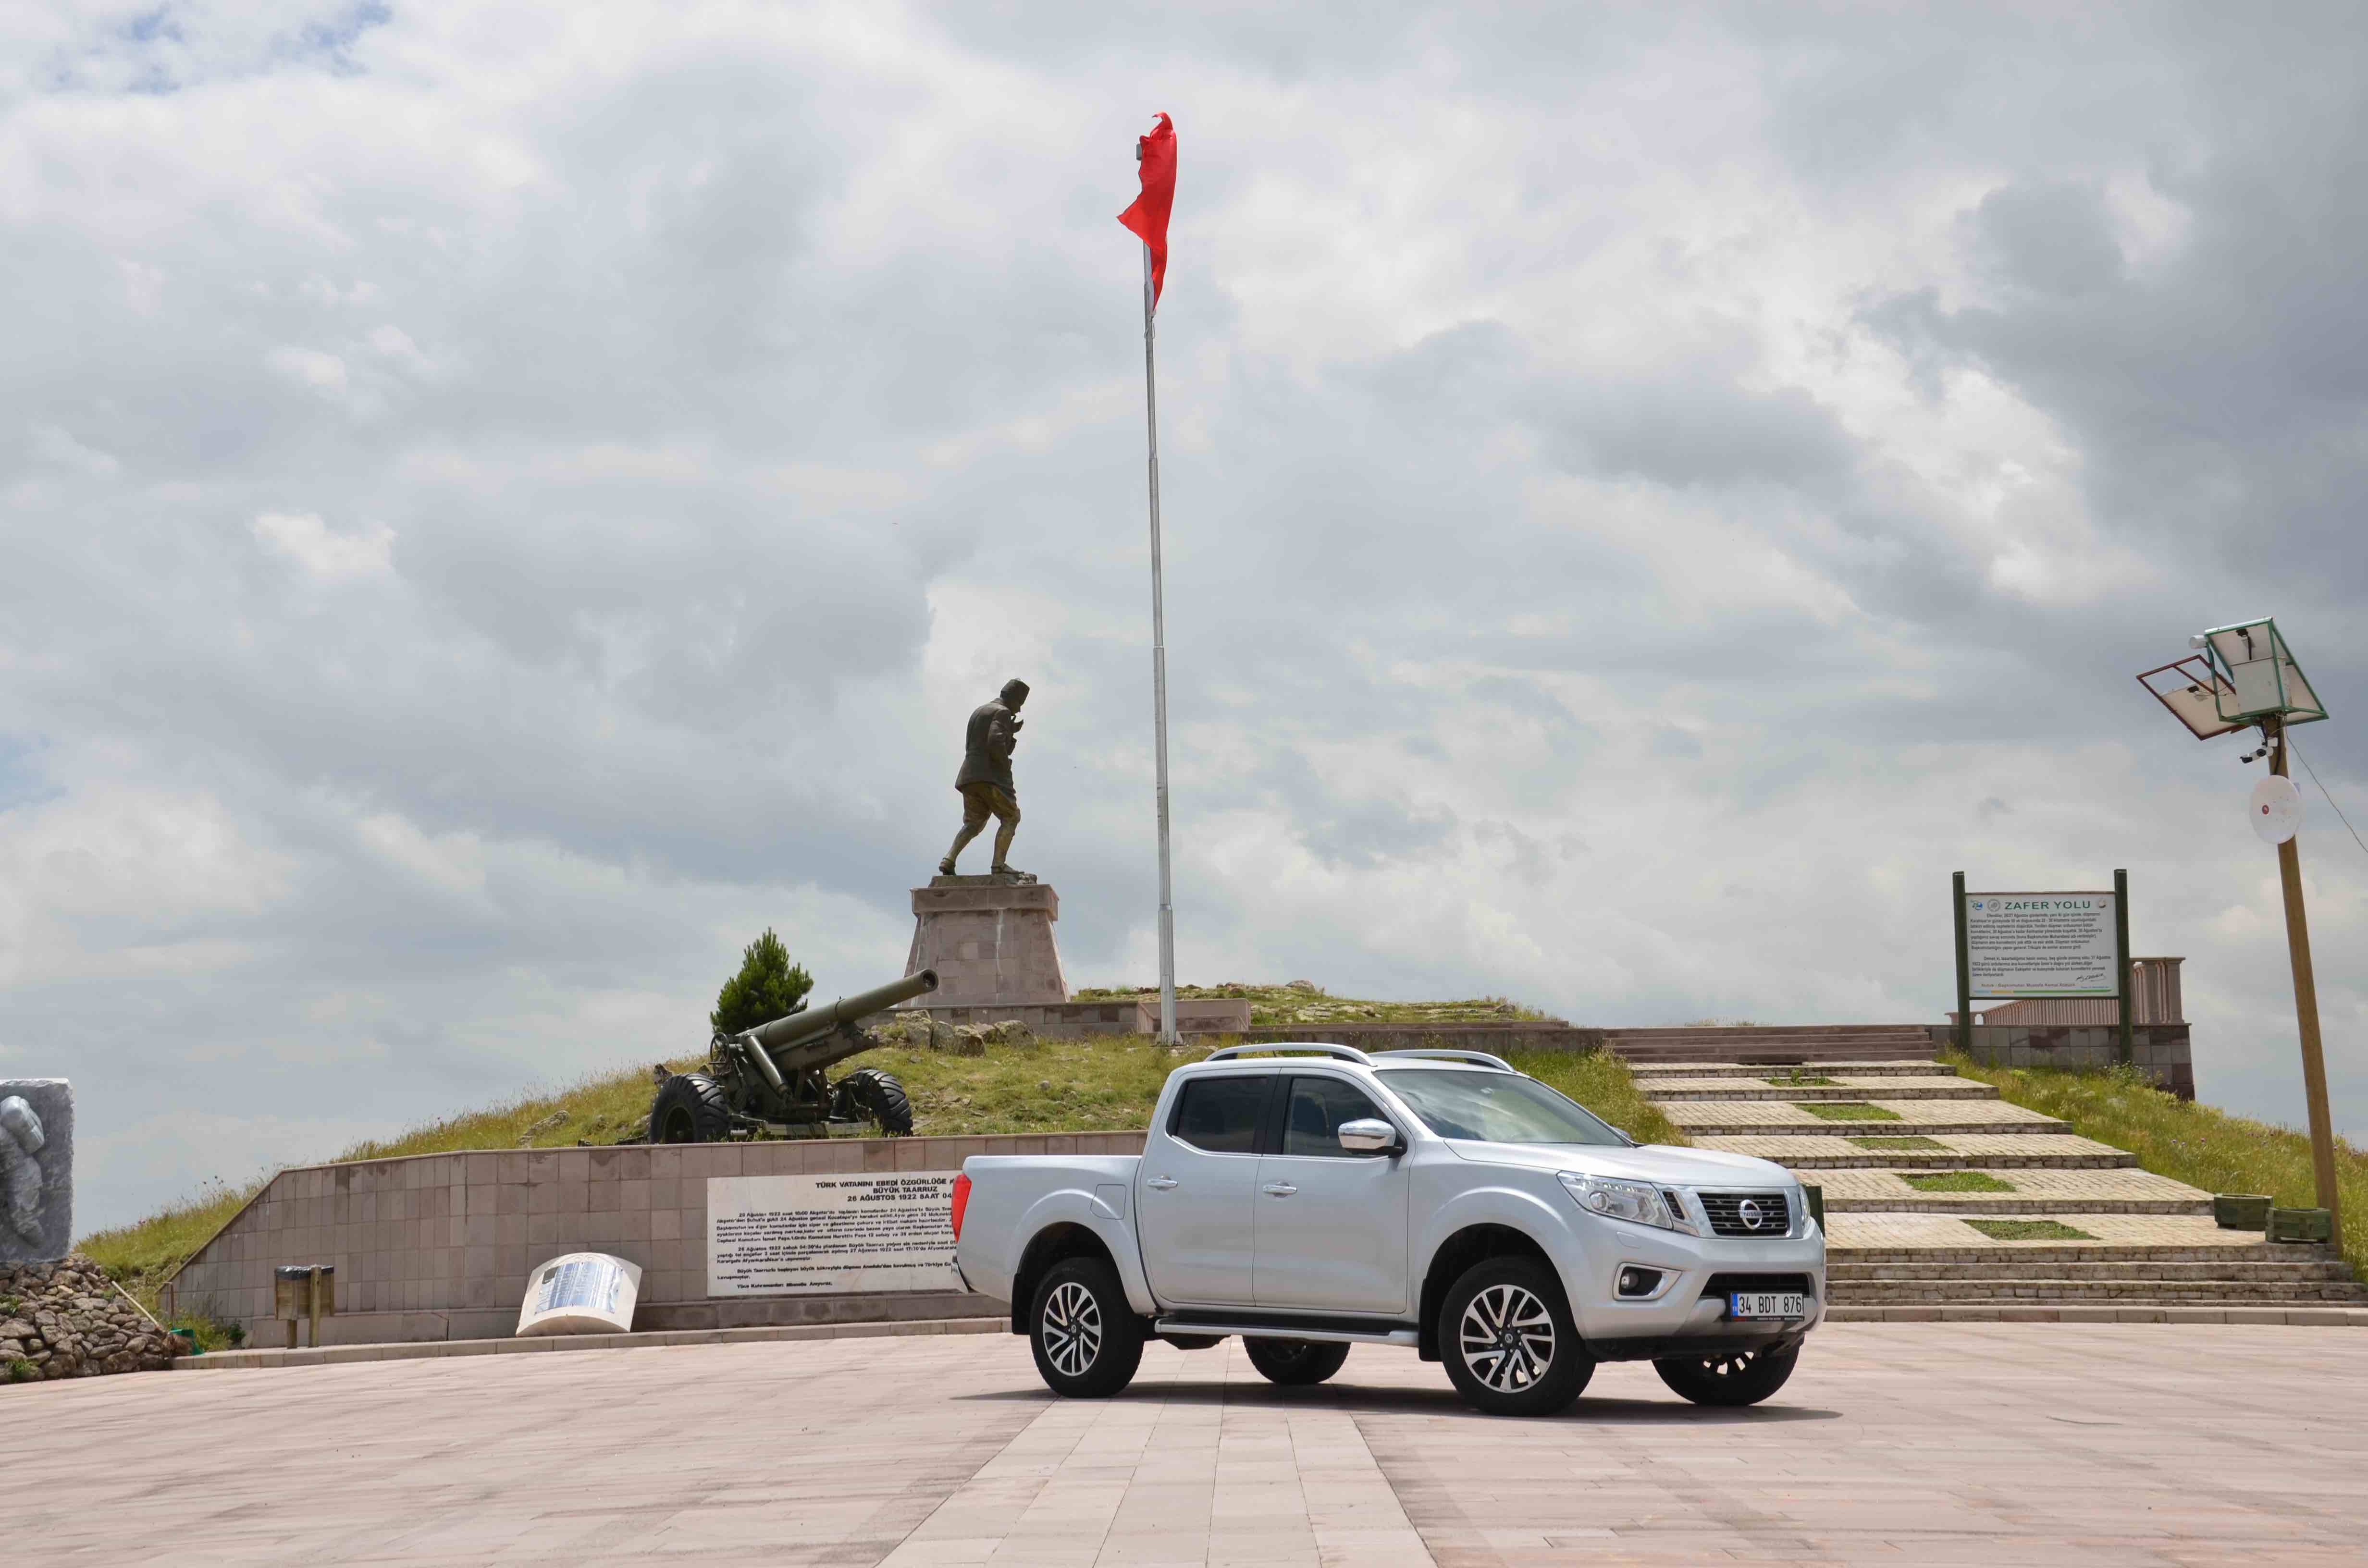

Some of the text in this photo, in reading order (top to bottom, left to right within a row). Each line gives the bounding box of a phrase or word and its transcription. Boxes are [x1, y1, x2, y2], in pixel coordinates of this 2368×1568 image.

[2004, 901, 2090, 910] ZAFER YOLU
[900, 1177, 947, 1186] ÖZGÜRLÜĞE
[1739, 1296, 1751, 1313] 34
[1758, 1296, 1776, 1313] BDT
[1784, 1296, 1801, 1313] 876
